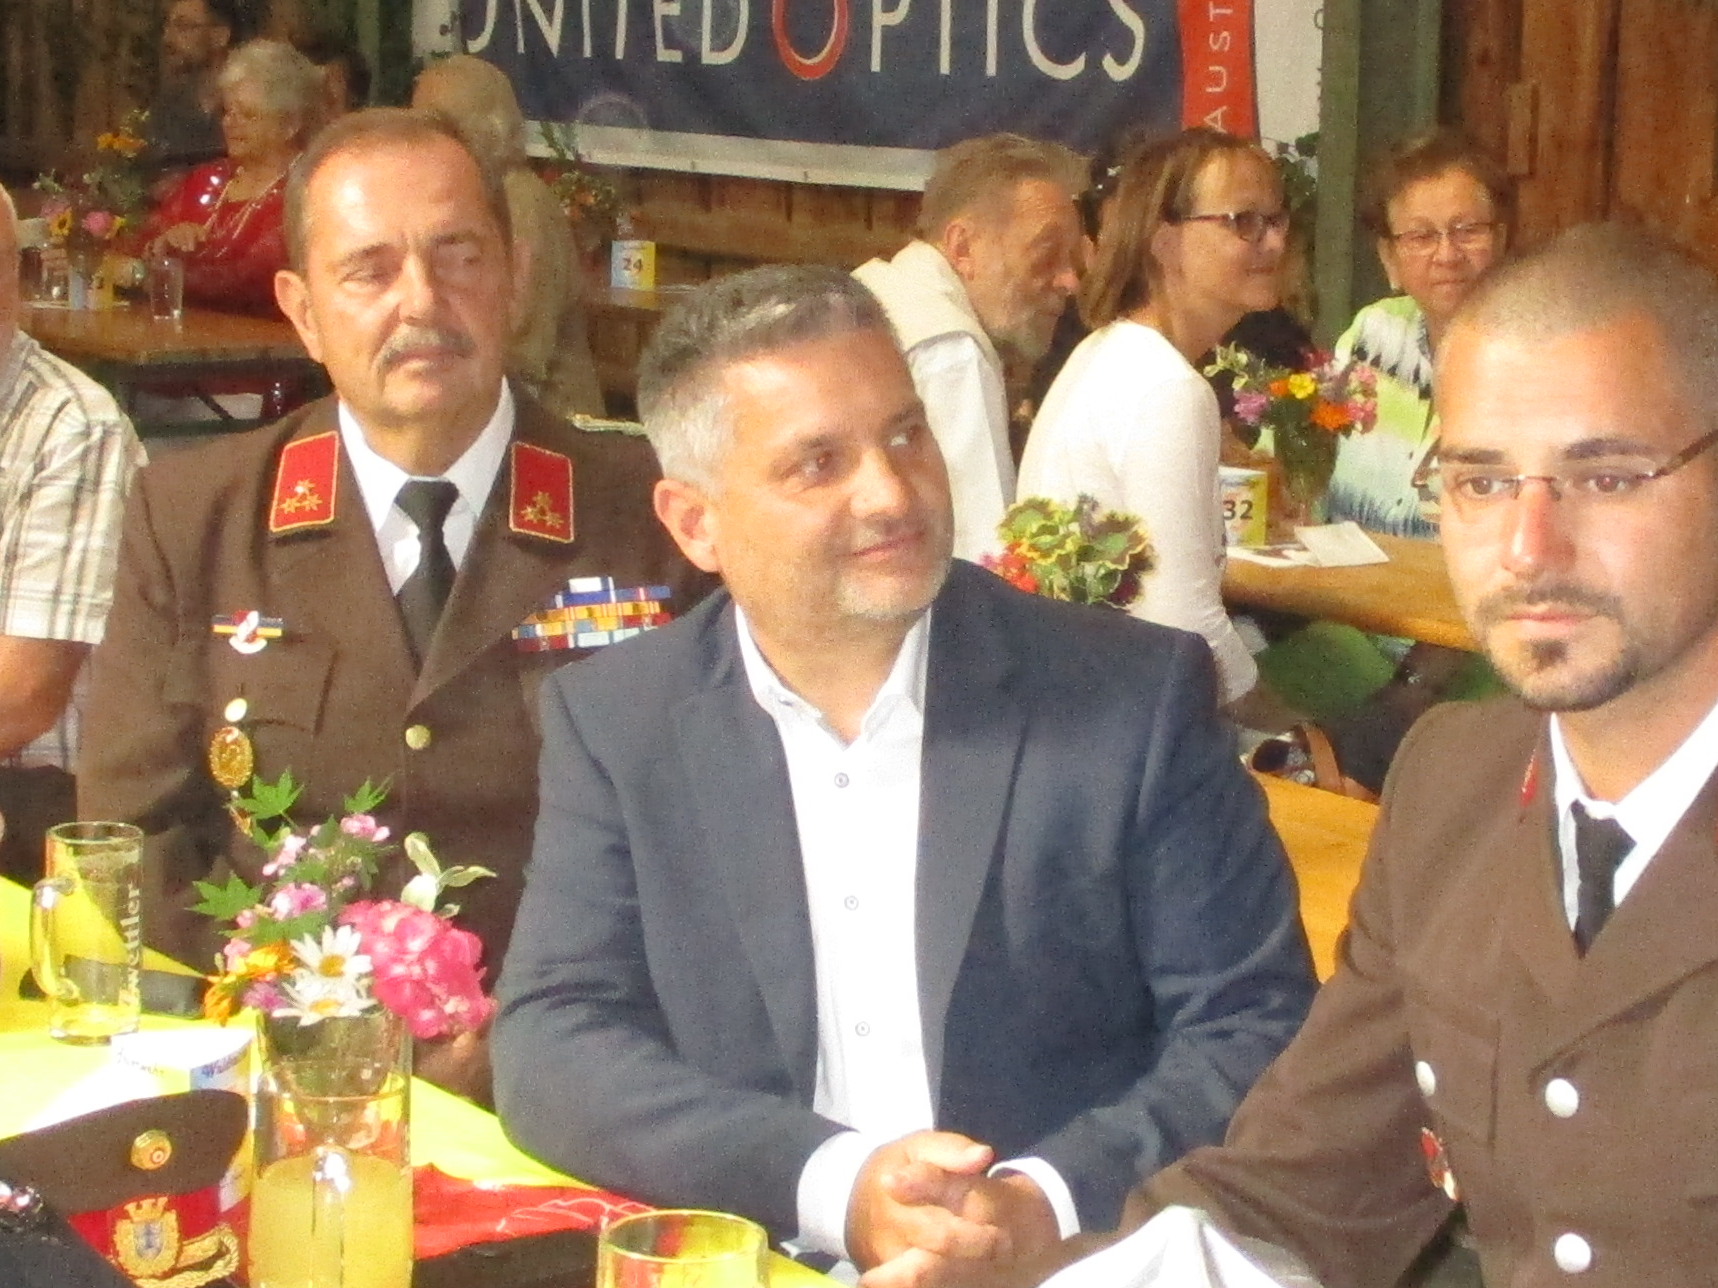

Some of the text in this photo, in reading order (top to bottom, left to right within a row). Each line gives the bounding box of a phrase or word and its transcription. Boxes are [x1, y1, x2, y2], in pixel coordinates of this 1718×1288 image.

[622, 257, 644, 273] 24
[1222, 499, 1254, 521] 32
[117, 882, 142, 1006] Zwettler
